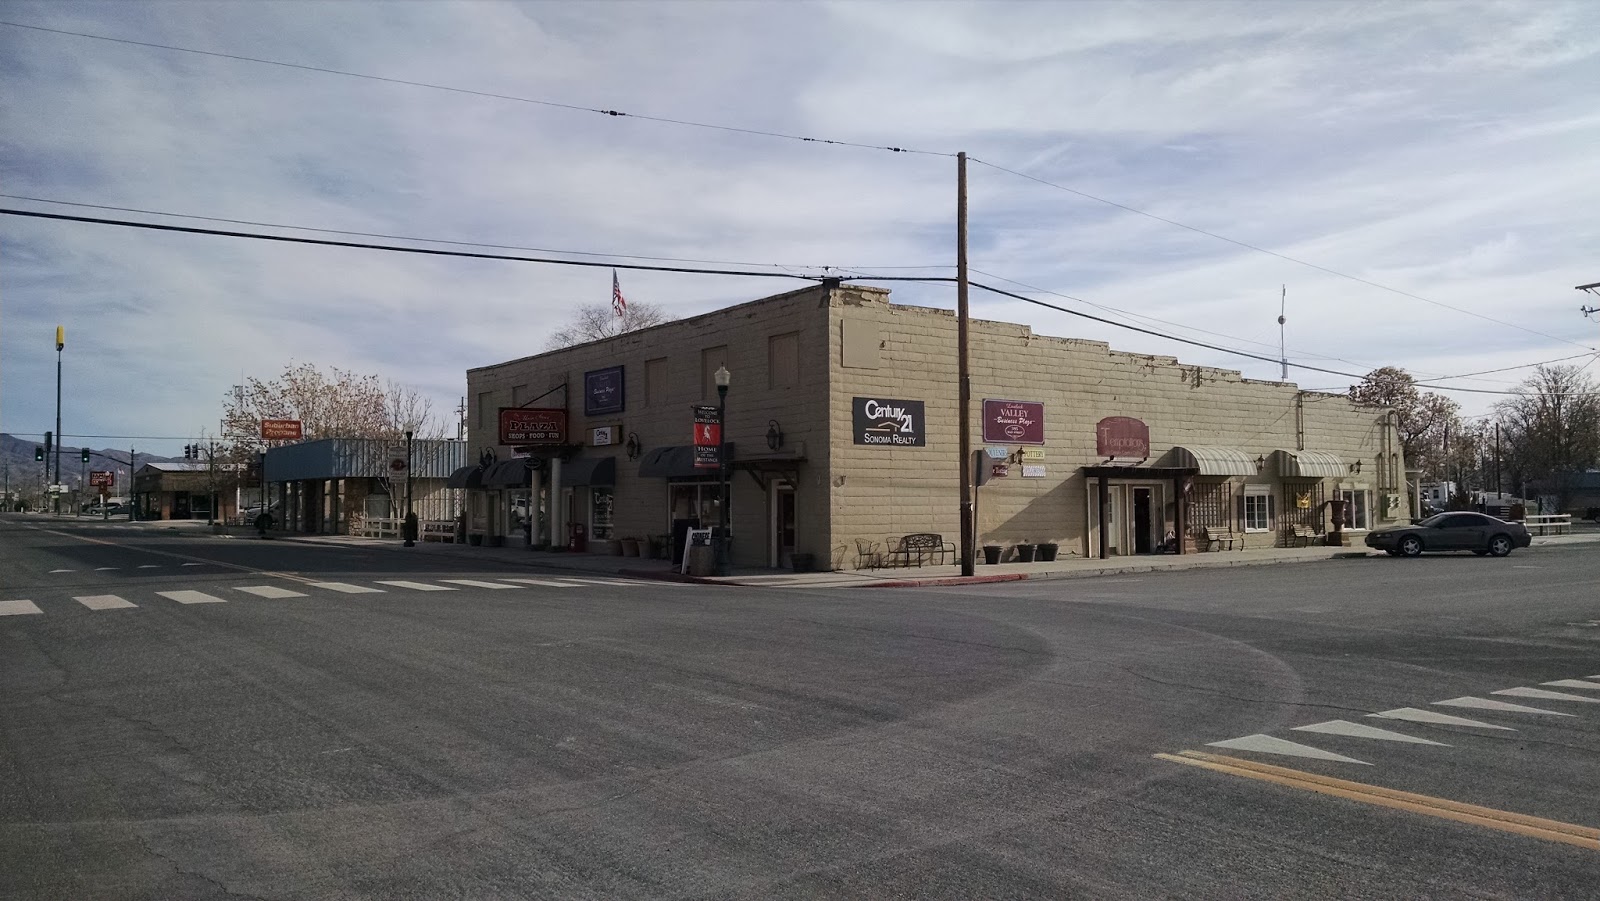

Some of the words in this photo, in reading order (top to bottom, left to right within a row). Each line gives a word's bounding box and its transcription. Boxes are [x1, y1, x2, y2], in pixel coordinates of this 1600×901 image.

[865, 400, 905, 421] Century
[901, 414, 912, 433] 21
[1001, 408, 1028, 418] VALLEY
[510, 420, 559, 432] PLAZA
[265, 429, 298, 437] Propane
[508, 432, 526, 440] SHOPS
[864, 433, 892, 443] SONOMA
[892, 433, 917, 445] REALTY
[1024, 450, 1044, 458] POTTERY
